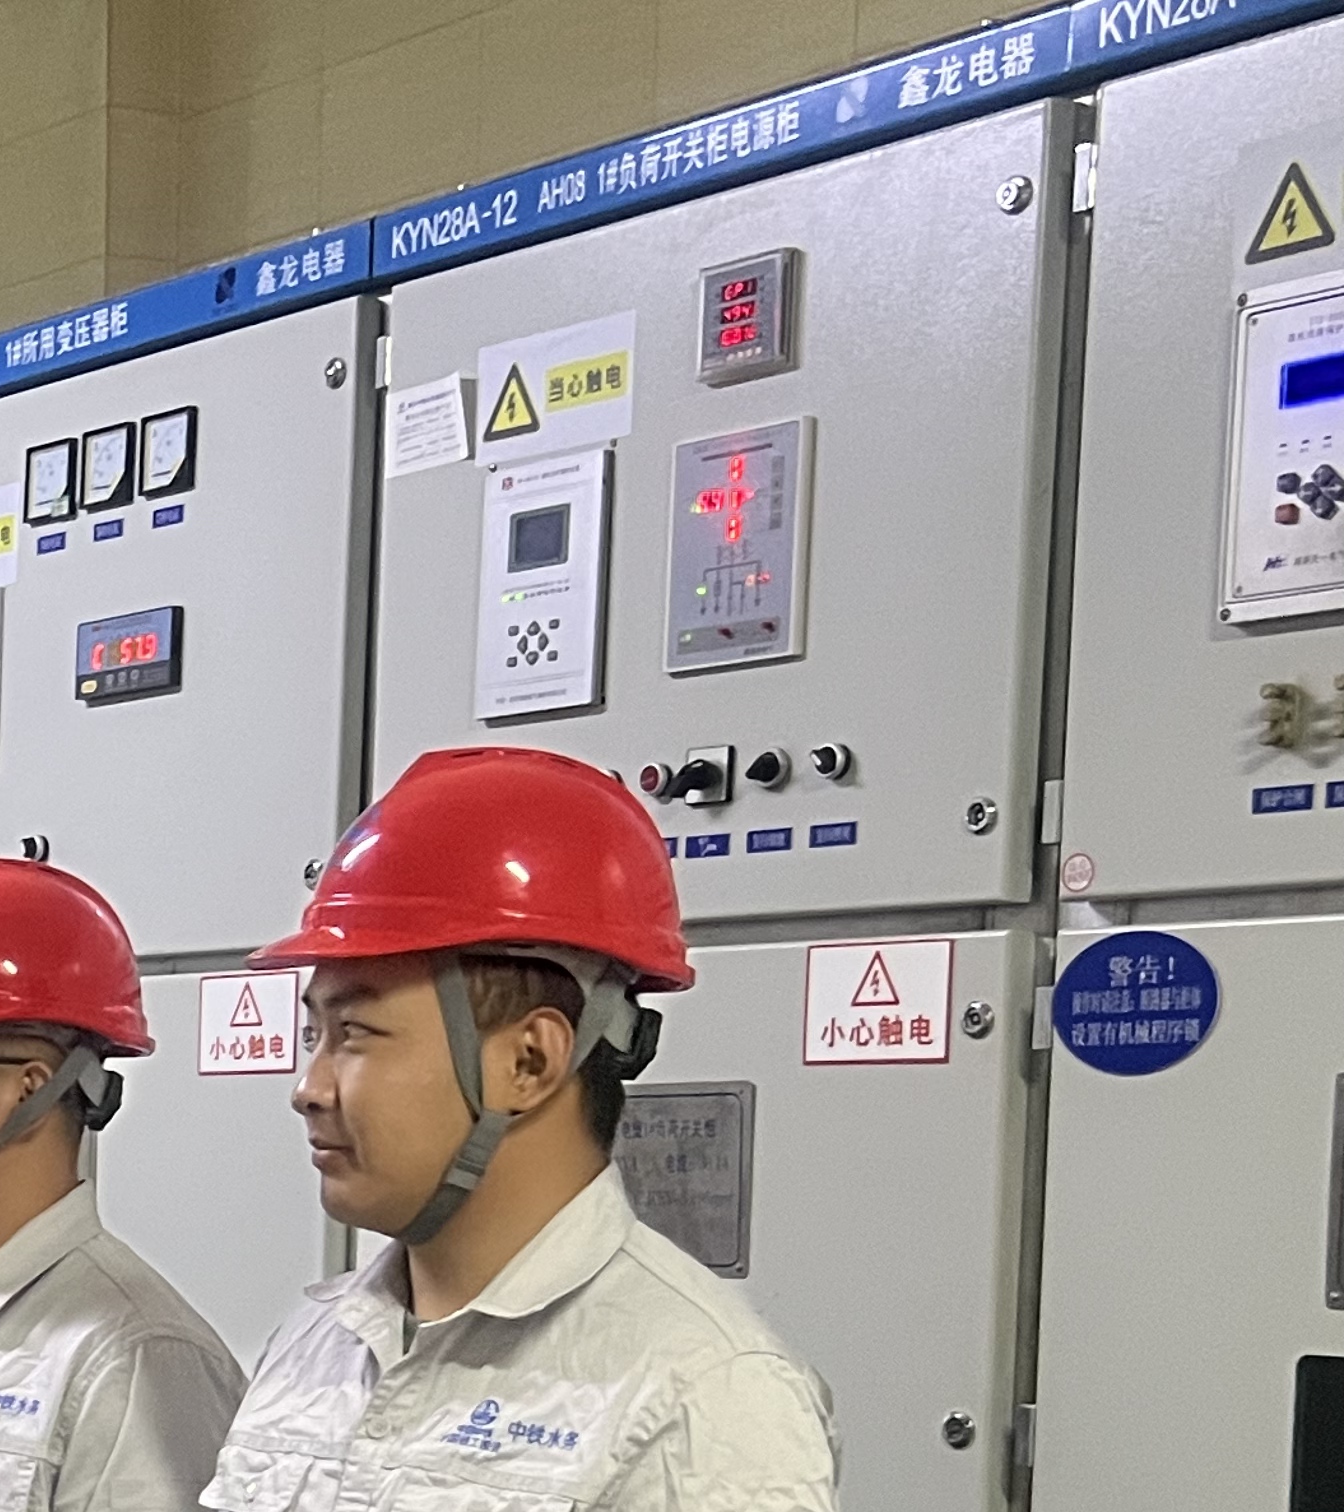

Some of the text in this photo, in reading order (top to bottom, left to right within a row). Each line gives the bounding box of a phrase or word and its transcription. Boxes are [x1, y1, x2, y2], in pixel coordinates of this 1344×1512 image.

[898, 32, 1035, 109] 鑫龙电器
[391, 189, 518, 259] KYN28A-12
[537, 170, 586, 213] AH08
[255, 239, 345, 297] 鑫龙电器
[547, 363, 623, 404] 当心触电
[209, 1033, 286, 1060] 小心触电
[820, 1013, 934, 1049] 小心触电
[508, 1420, 579, 1451] 中铁水务
